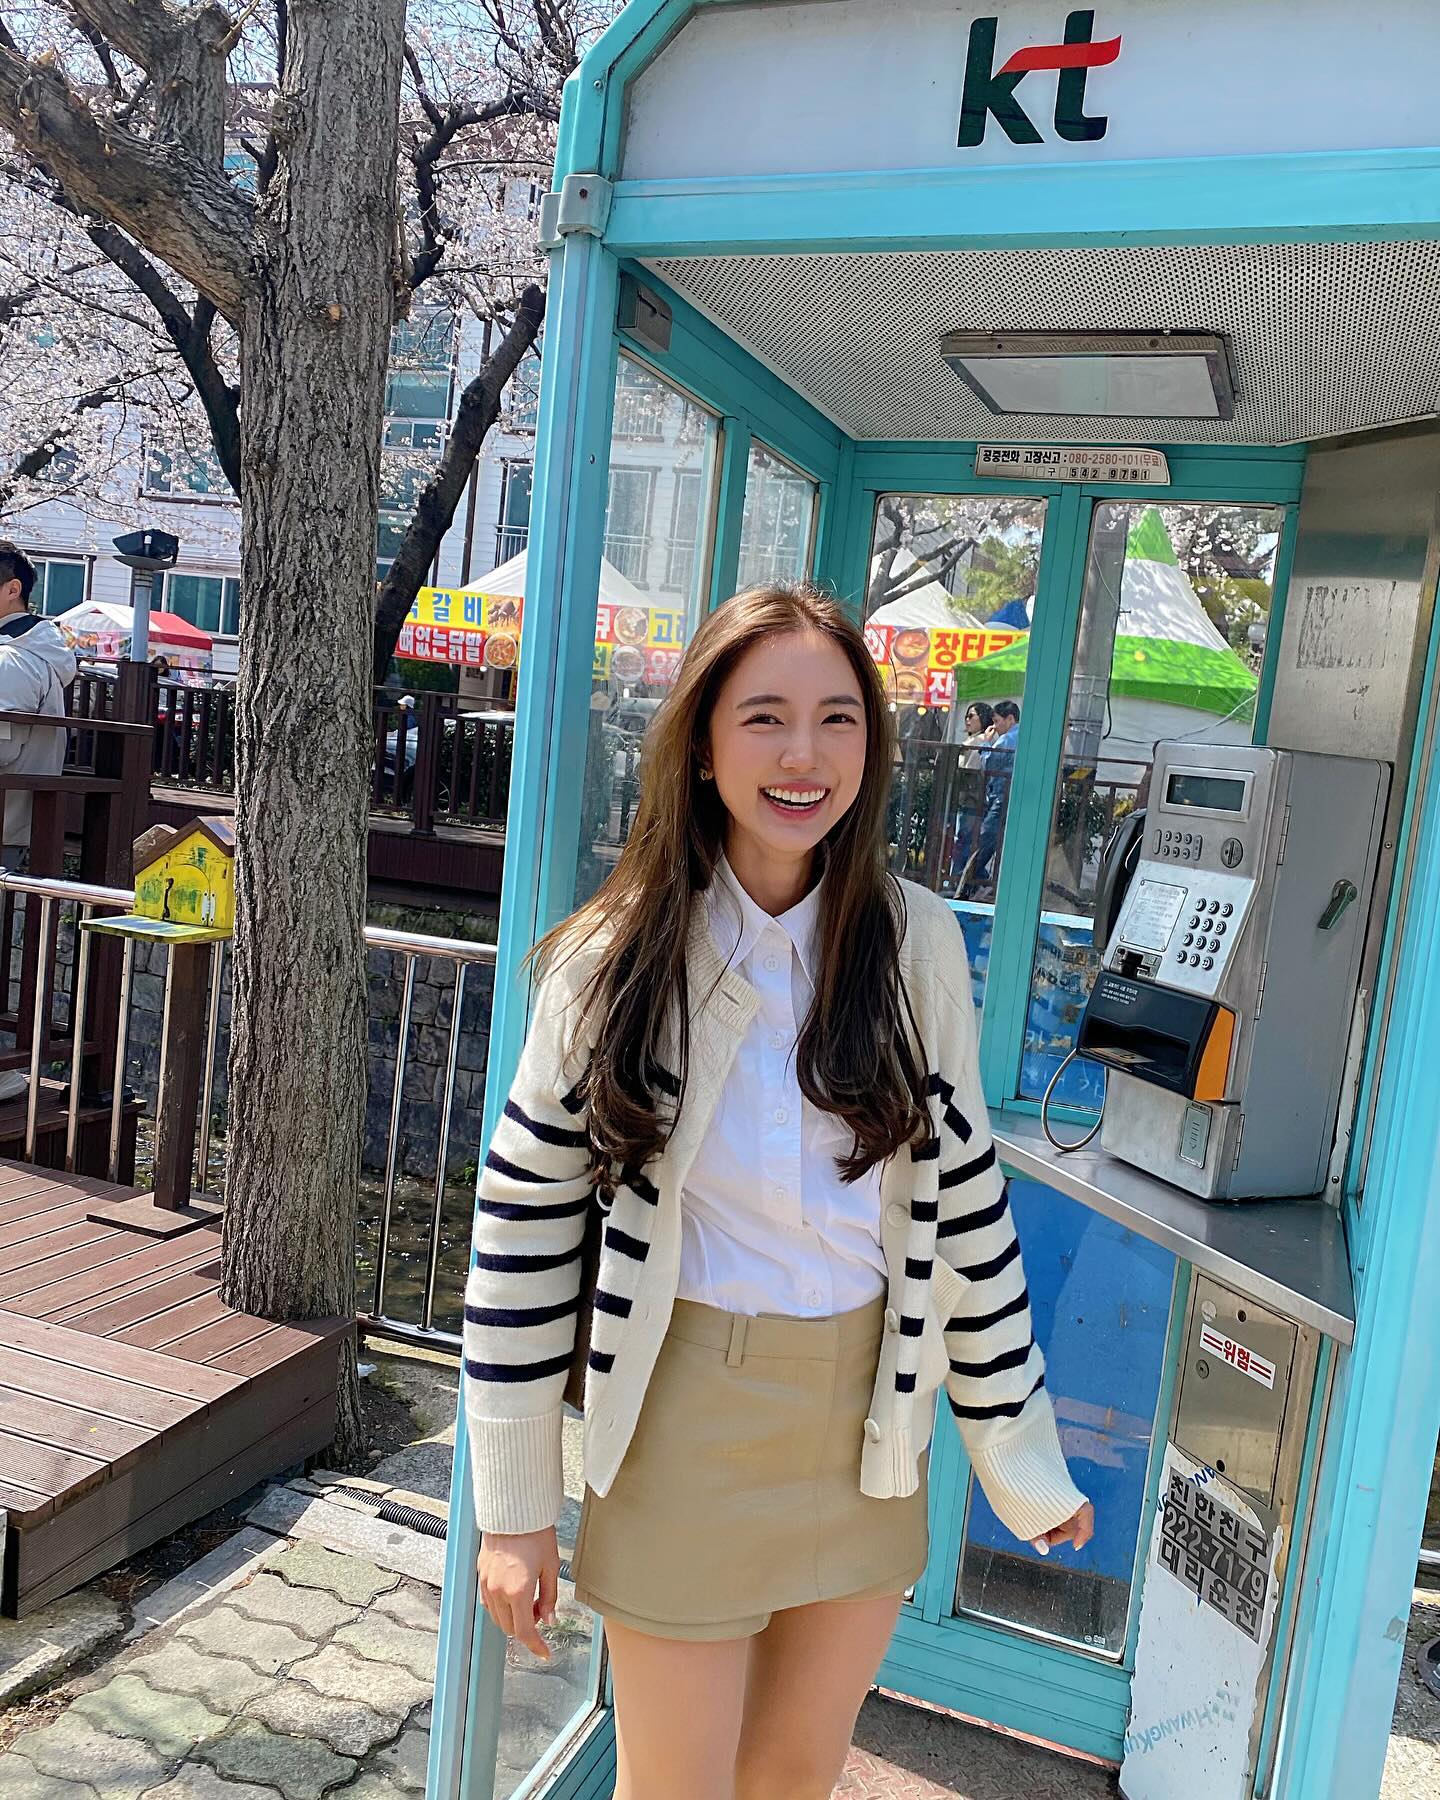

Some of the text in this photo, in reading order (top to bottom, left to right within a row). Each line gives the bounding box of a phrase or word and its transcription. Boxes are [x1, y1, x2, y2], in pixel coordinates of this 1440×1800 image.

[957, 10, 1121, 147] kt
[983, 450, 1020, 463] 공중전화
[1048, 467, 1056, 476] 구
[1223, 1339, 1251, 1373] 위험
[1161, 1537, 1258, 1637] 대리운전
[1163, 1507, 1266, 1603] 222-7179
